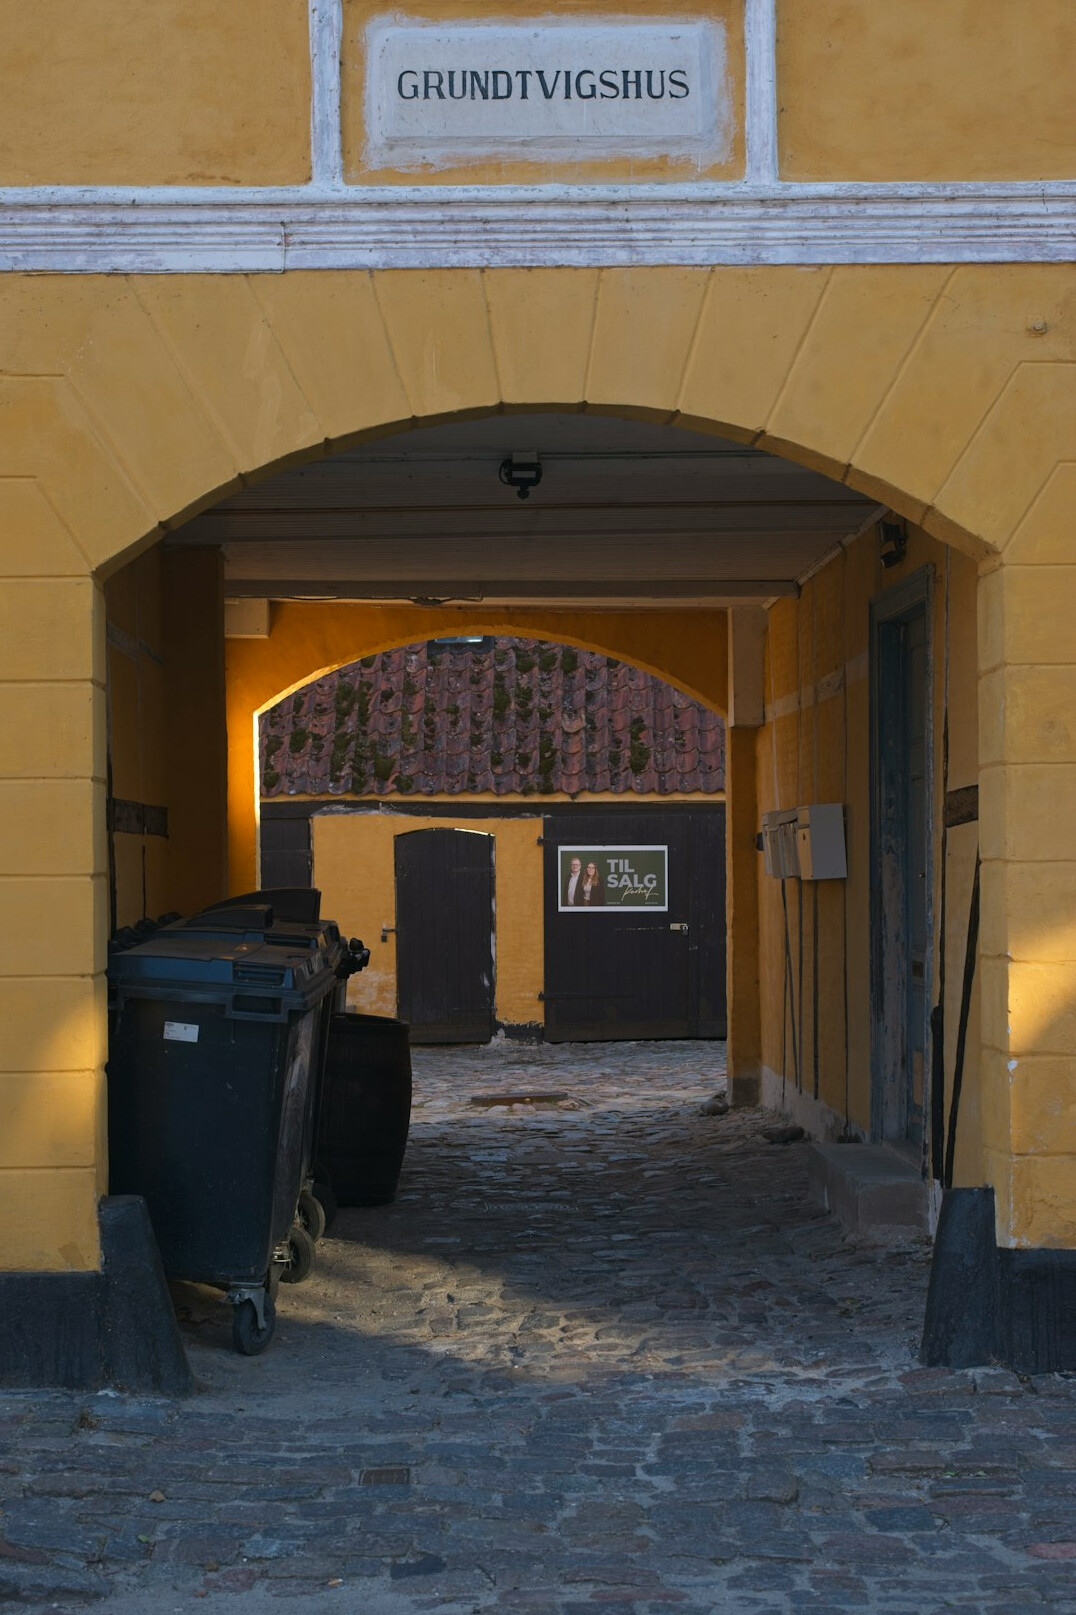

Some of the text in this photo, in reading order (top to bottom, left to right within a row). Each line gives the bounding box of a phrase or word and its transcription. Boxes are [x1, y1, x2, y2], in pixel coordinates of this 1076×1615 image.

[397, 69, 690, 100] GRUNDTVIGSHUS
[606, 858, 635, 873] TIL
[607, 874, 657, 888] SALG
